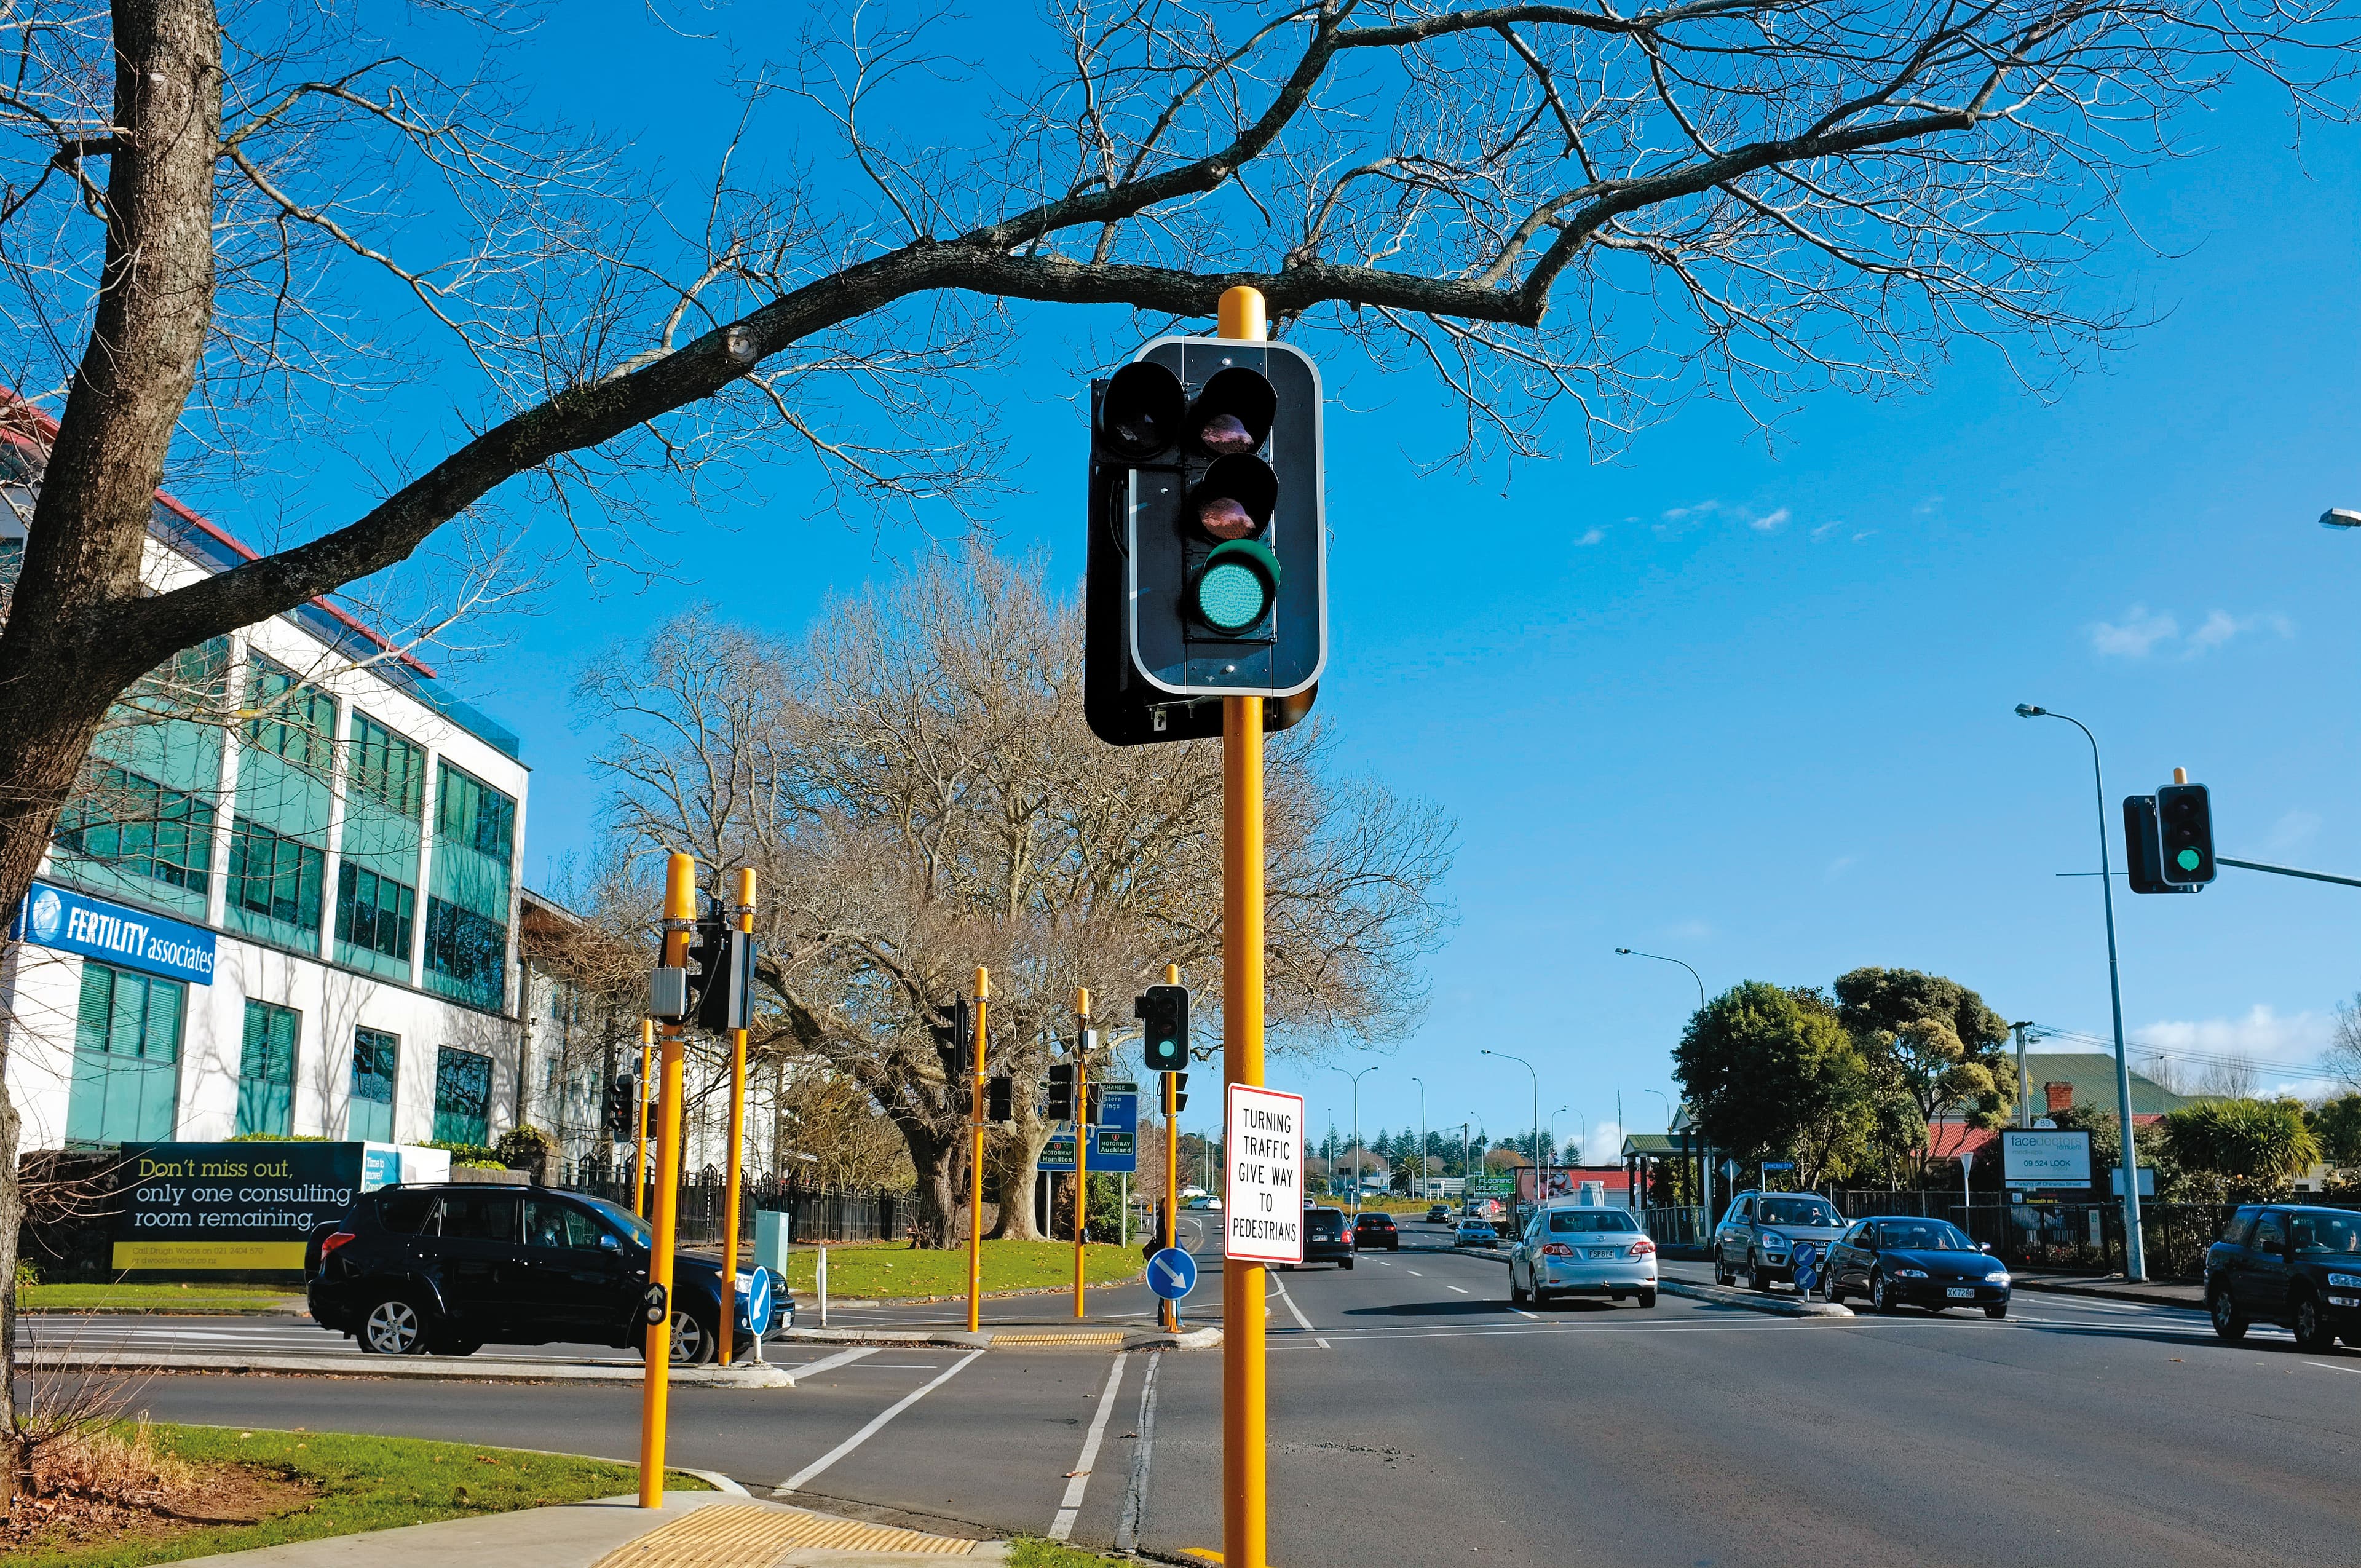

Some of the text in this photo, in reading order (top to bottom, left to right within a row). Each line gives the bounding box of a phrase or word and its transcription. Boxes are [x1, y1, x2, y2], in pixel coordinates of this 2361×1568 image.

[66, 906, 213, 974] FERTILITY associates
[1243, 1108, 1291, 1133] TURNING
[1244, 1136, 1290, 1160] TRAFFIC
[200, 1159, 248, 1178] miss
[253, 1160, 294, 1179] out,
[366, 1157, 379, 1168] Time
[366, 1170, 384, 1180] move?
[1238, 1163, 1293, 1187] GIVE WAY
[136, 1184, 352, 1206] only one consulting
[1260, 1193, 1273, 1212] TO
[135, 1209, 314, 1231] room remaining.
[1233, 1218, 1296, 1242] PEDESTRIANS
